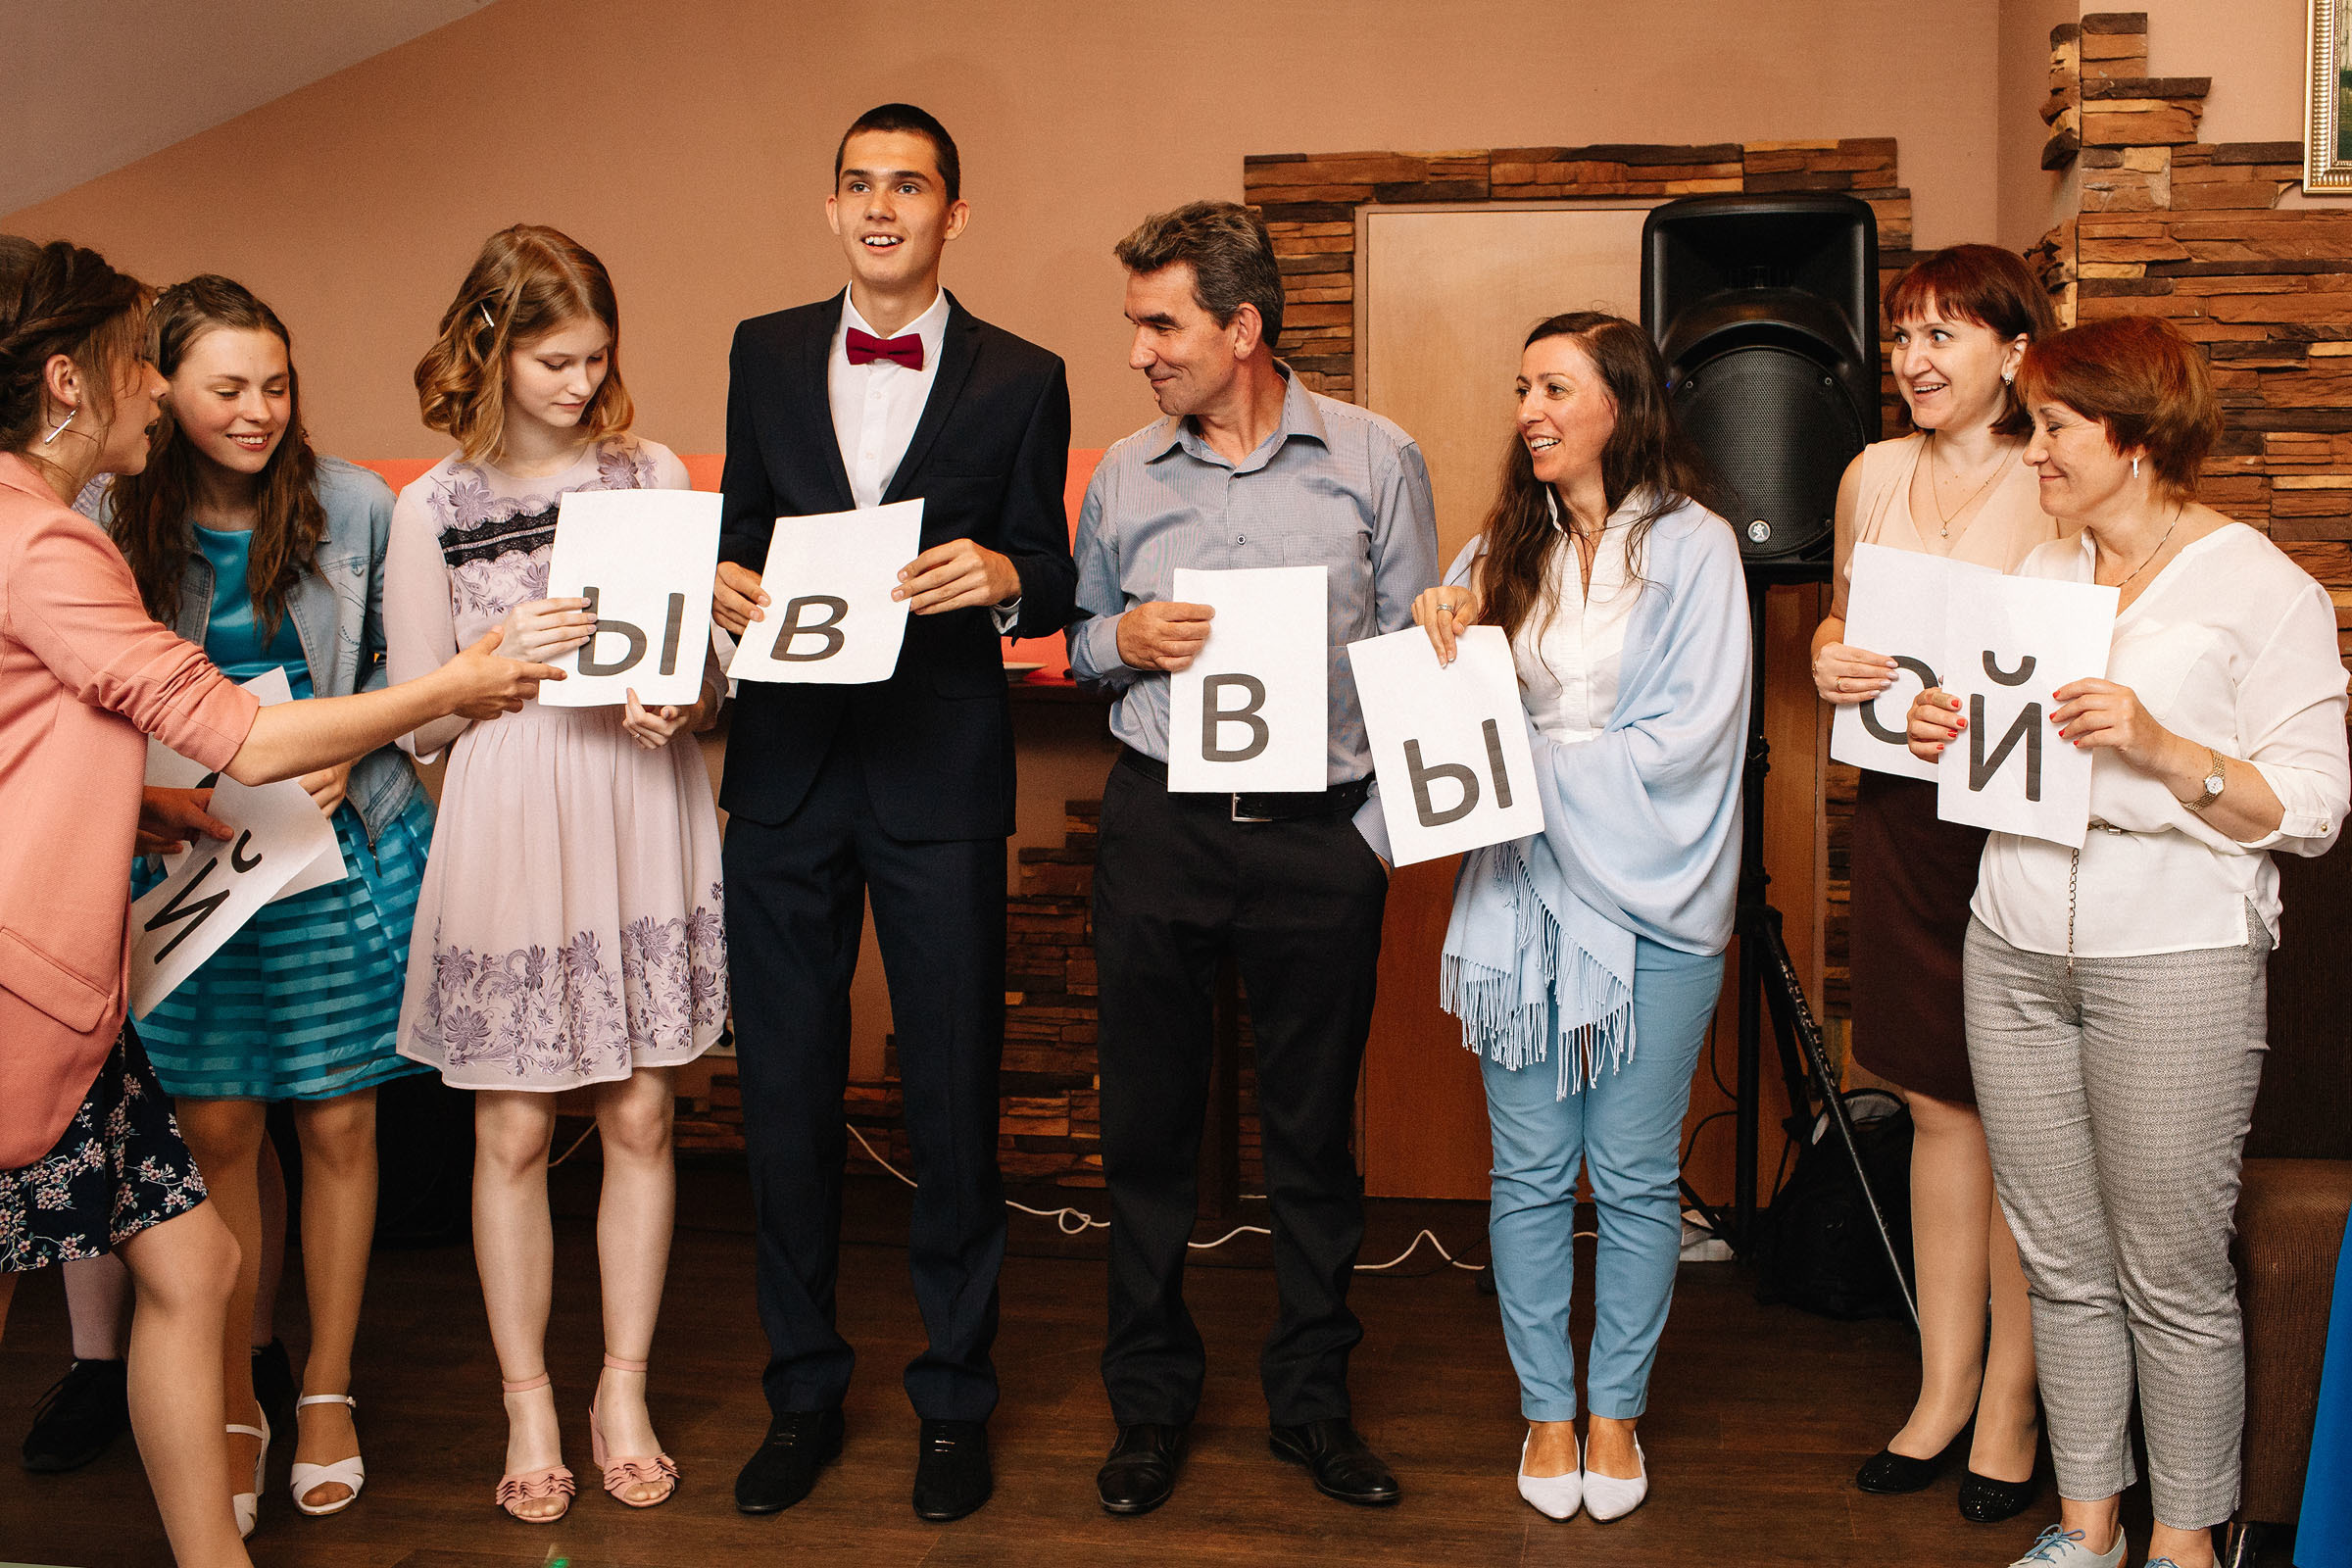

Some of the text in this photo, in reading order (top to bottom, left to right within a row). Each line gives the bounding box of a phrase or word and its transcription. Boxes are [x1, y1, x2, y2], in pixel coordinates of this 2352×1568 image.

[577, 586, 684, 676] Ы
[770, 595, 849, 662] В
[1201, 673, 1269, 762] В
[1969, 650, 2041, 802] Й
[1403, 718, 1513, 828] Ы
[144, 829, 262, 965] Й
